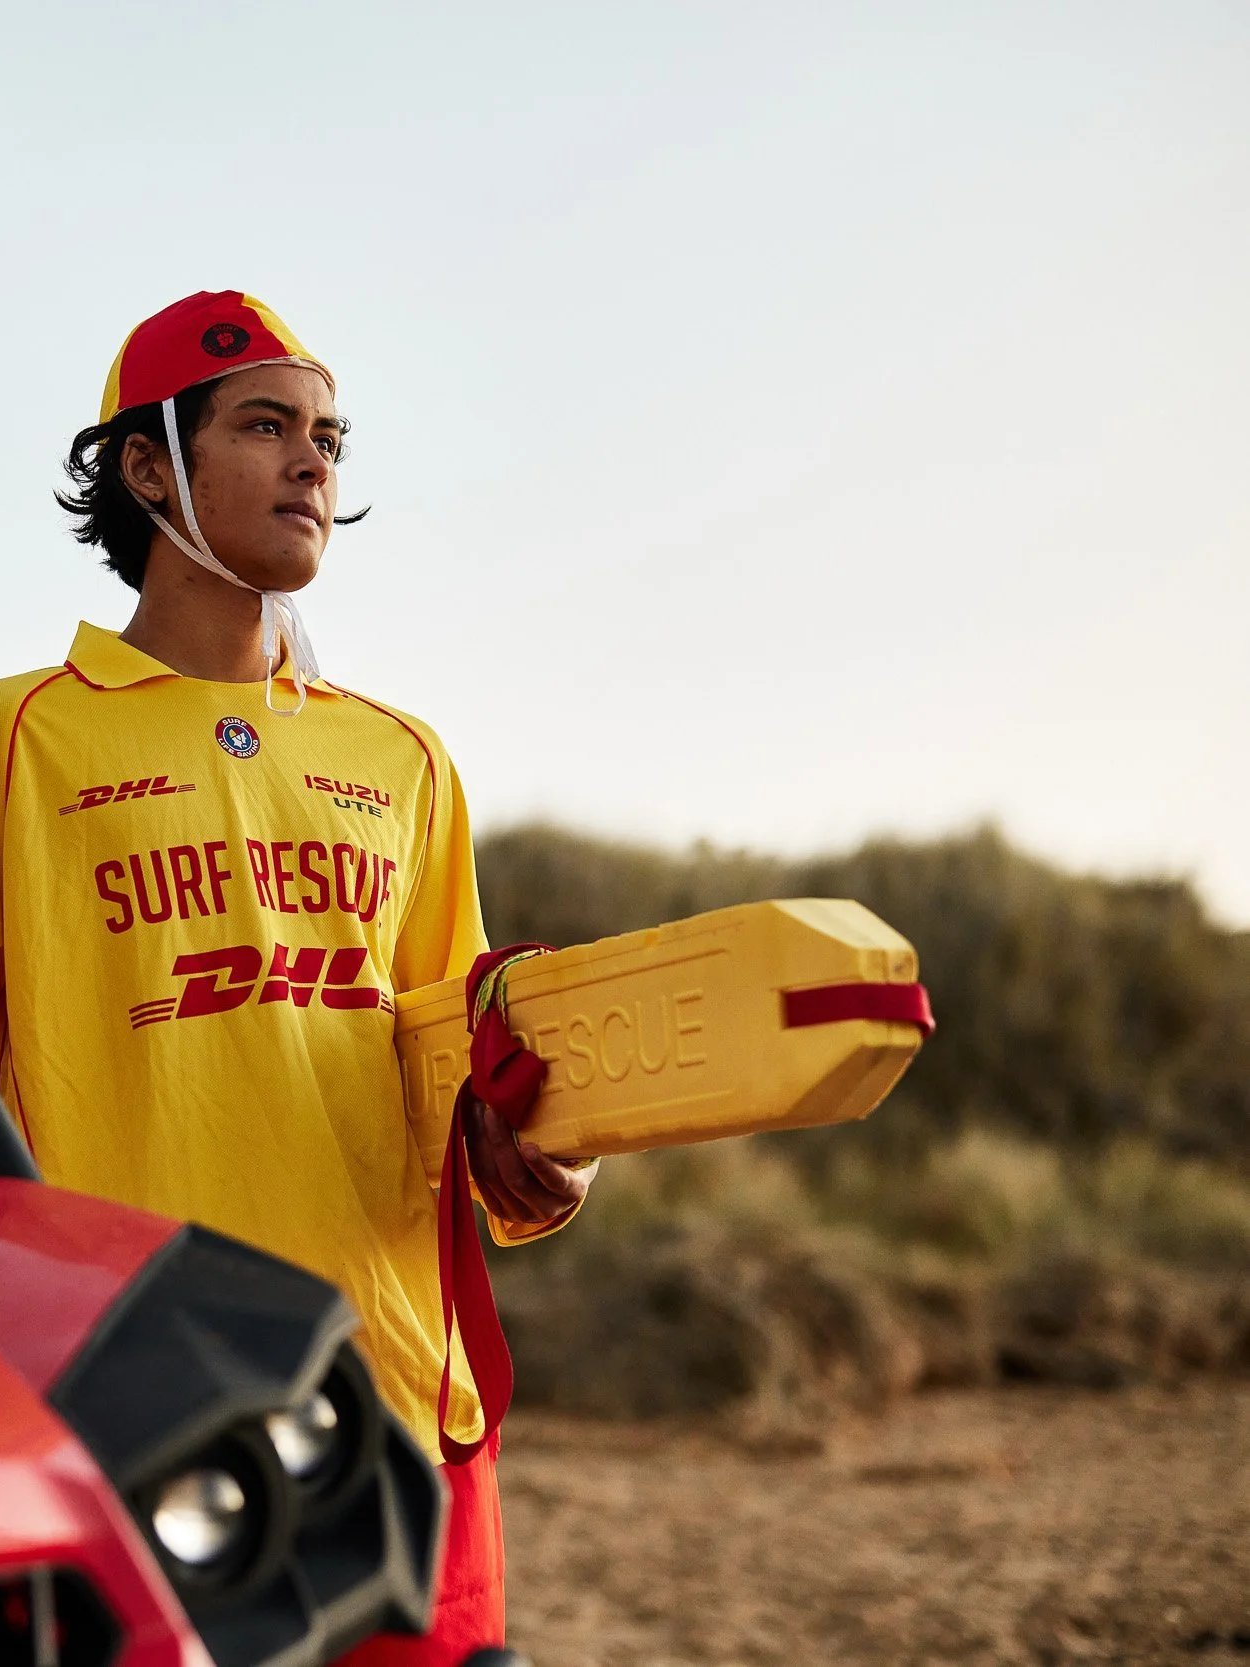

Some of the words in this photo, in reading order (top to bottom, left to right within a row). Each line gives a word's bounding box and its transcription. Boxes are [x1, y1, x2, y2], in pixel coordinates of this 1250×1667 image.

[222, 718, 247, 726] SURF
[218, 738, 235, 754] LIFE
[237, 739, 259, 757] SAVING
[78, 775, 180, 811] DHL
[304, 774, 390, 807] ISUZU
[333, 797, 383, 819] UTE
[94, 841, 232, 934] SURF
[170, 943, 382, 1020] DHL
[511, 989, 707, 1096] ESCUE
